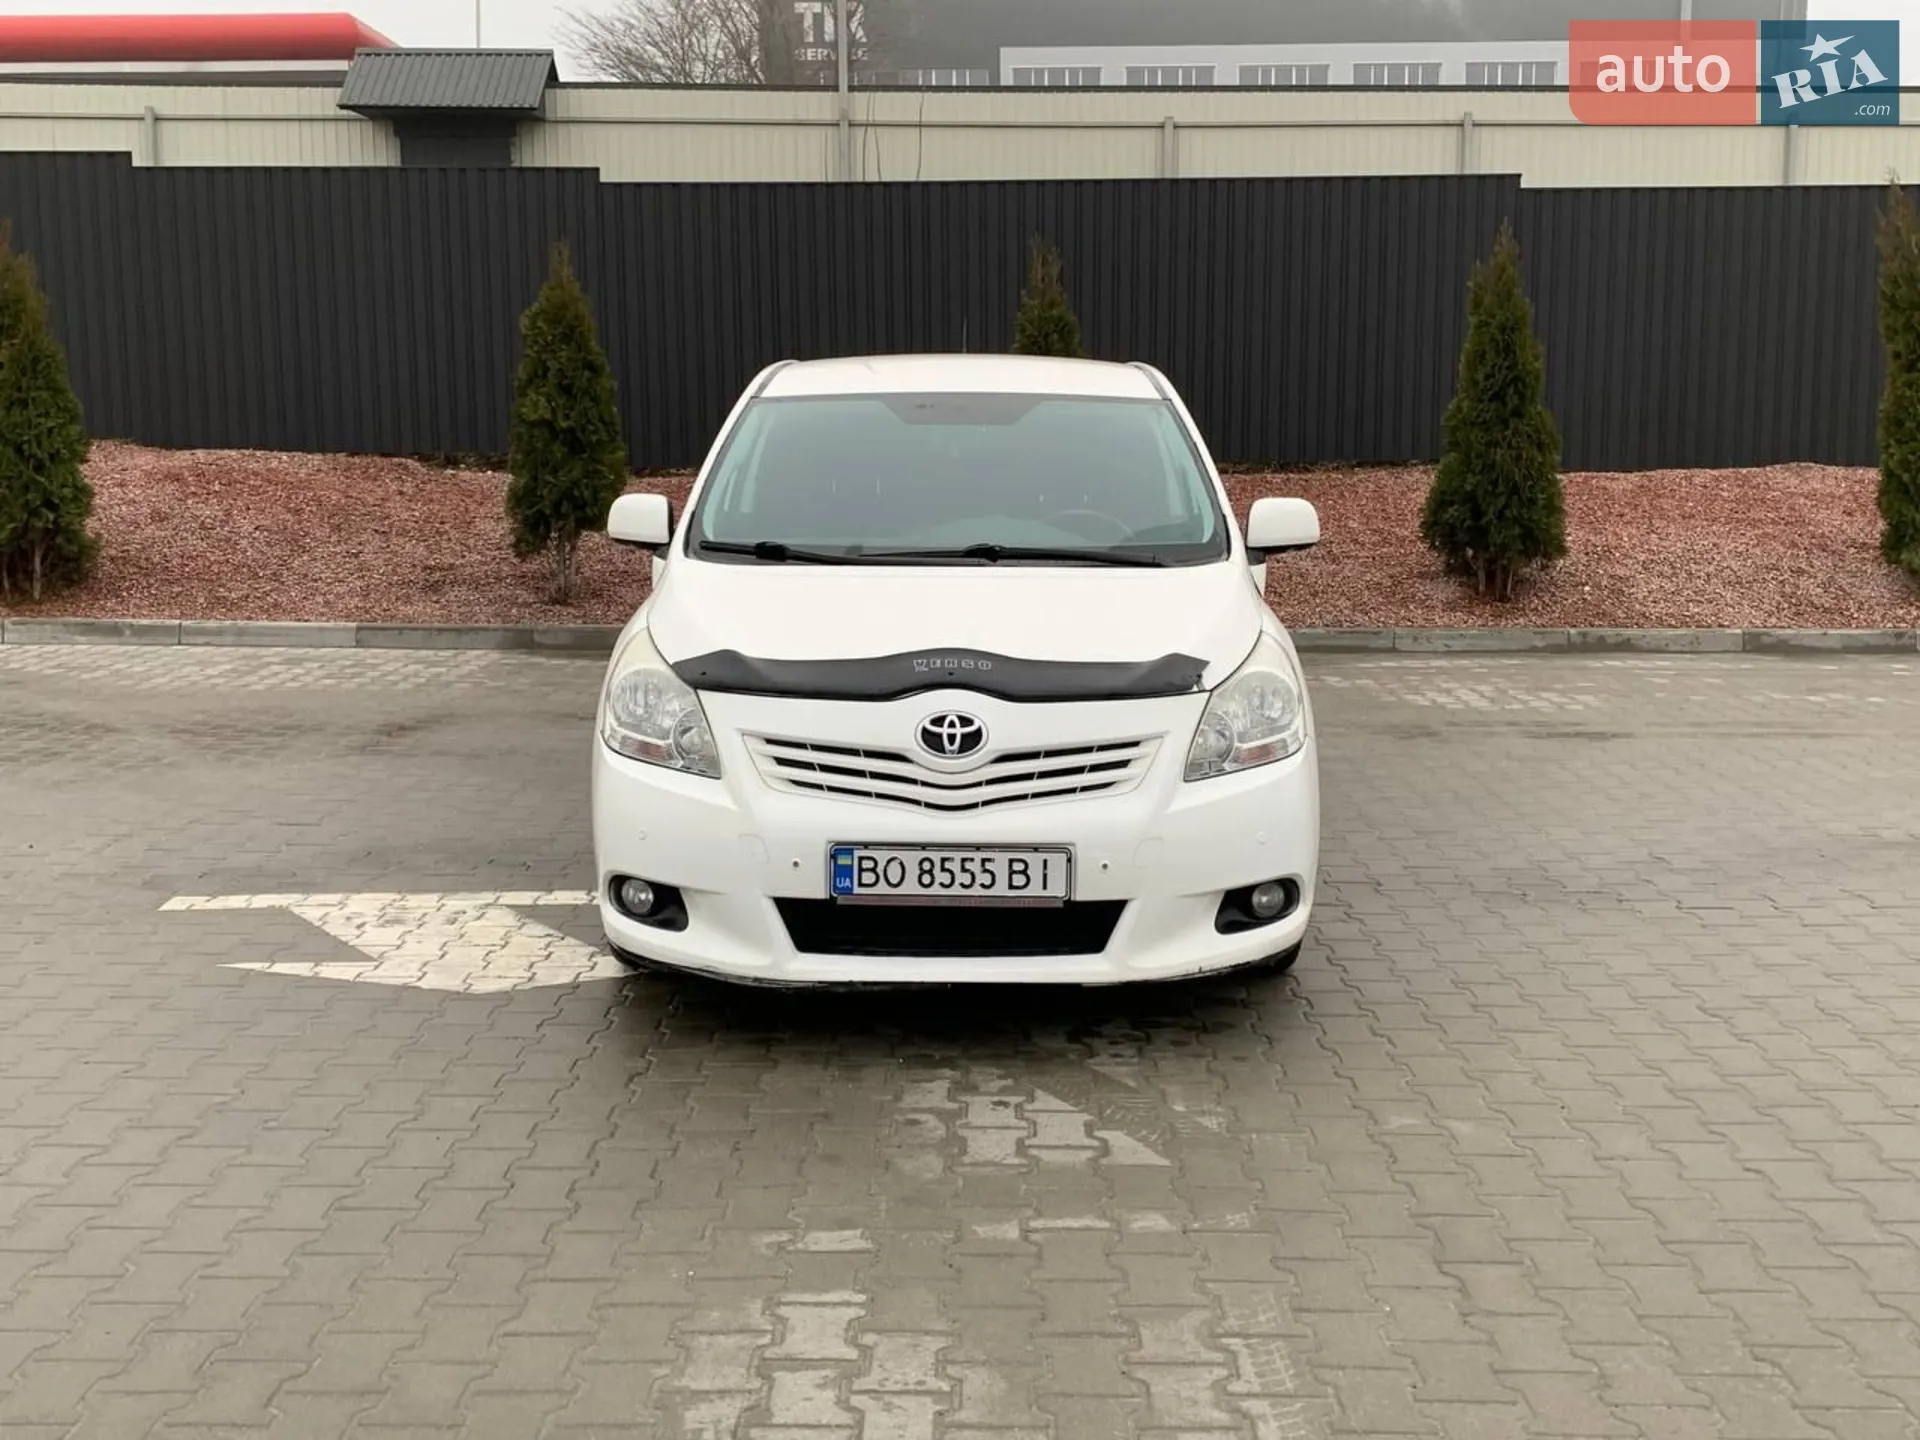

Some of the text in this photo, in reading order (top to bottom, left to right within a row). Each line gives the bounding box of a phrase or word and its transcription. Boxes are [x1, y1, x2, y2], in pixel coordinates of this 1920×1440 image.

[836, 877, 852, 888] UA
[857, 855, 906, 888] BO
[917, 857, 996, 889] 8555
